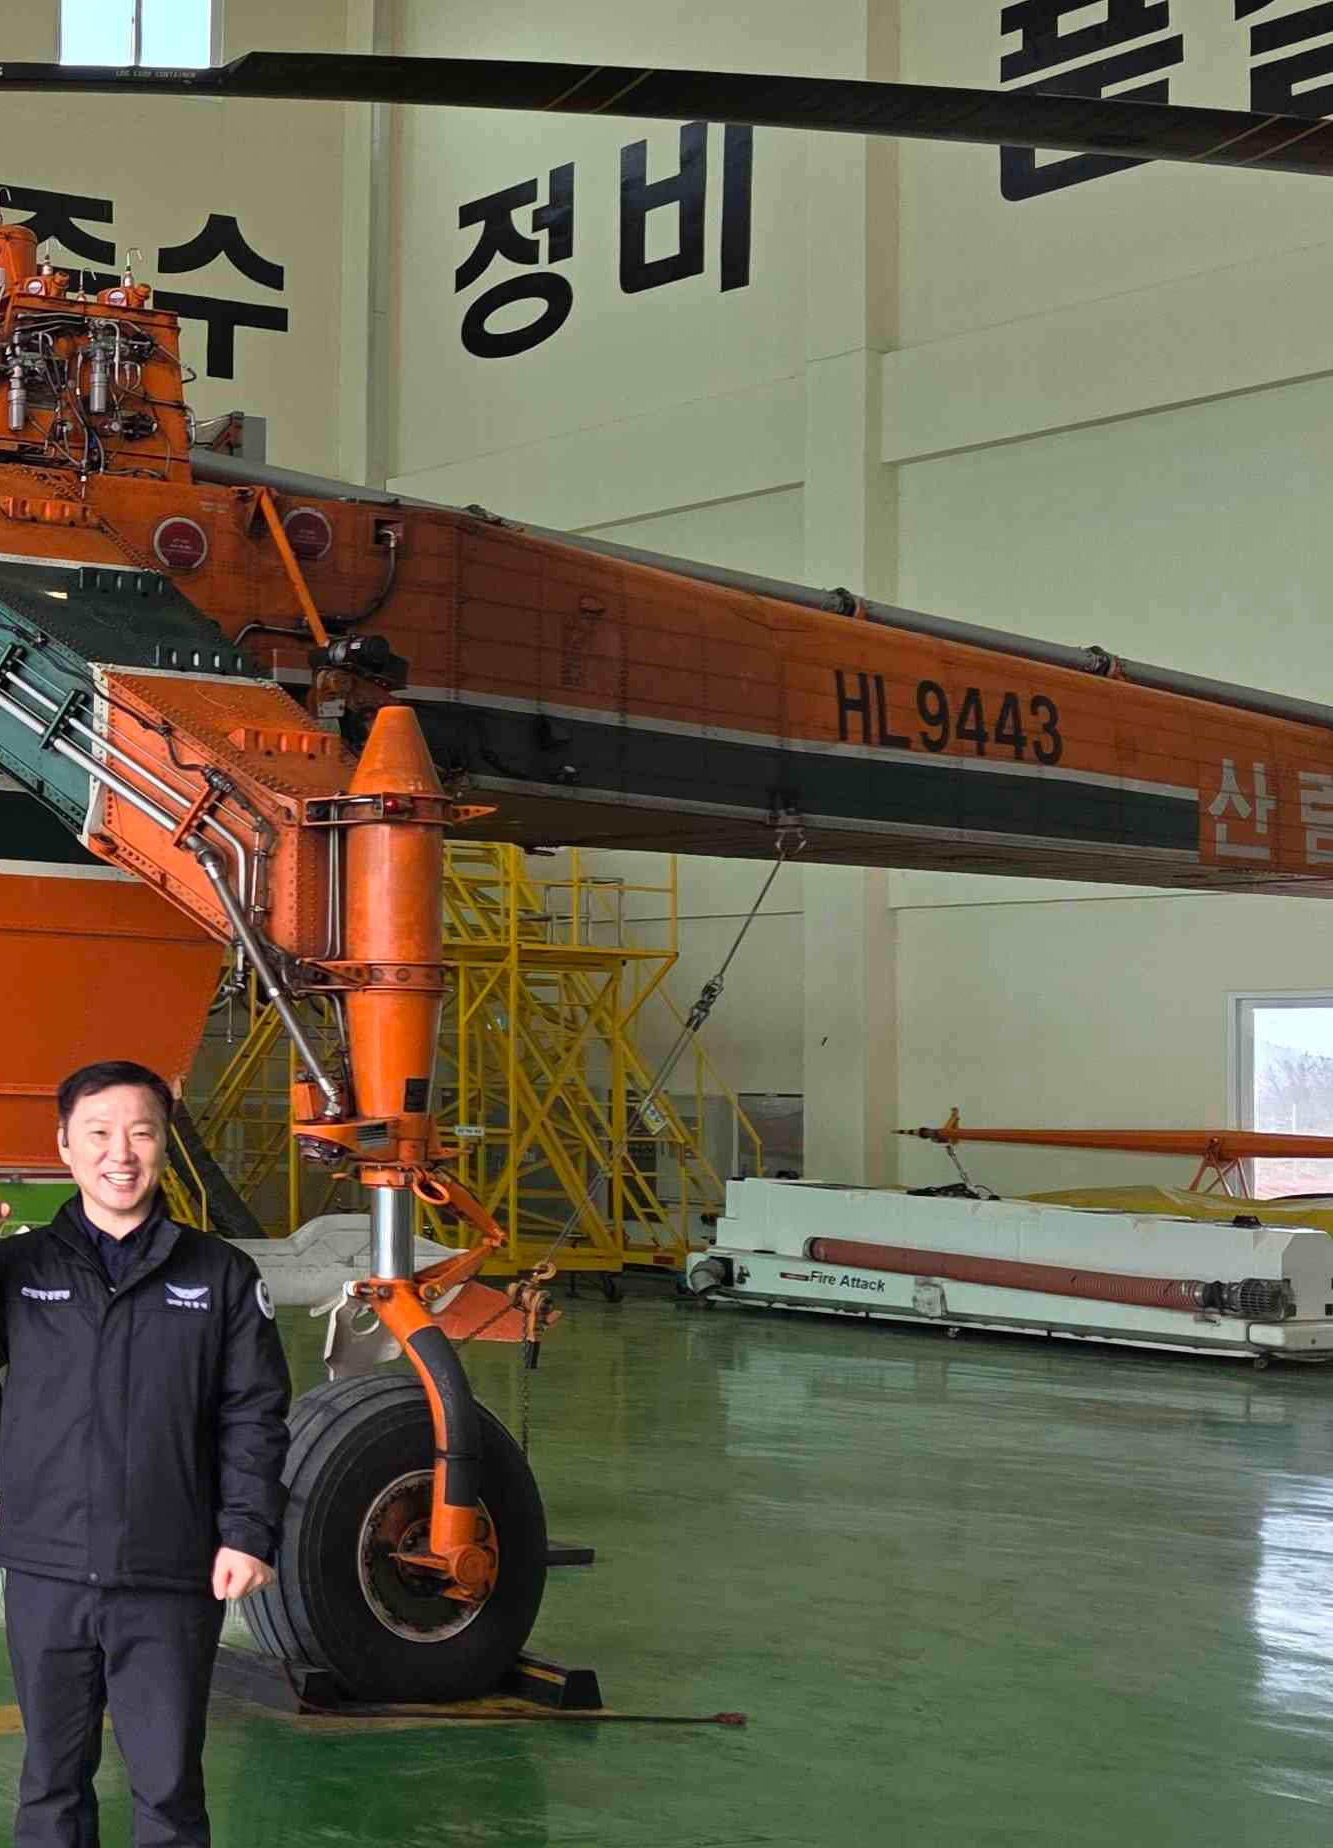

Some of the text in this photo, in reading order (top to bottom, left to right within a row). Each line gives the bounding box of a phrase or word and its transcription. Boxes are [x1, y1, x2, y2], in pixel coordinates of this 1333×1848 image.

[454, 123, 754, 360] 정비
[809, 1271, 886, 1292] Fire Attack
